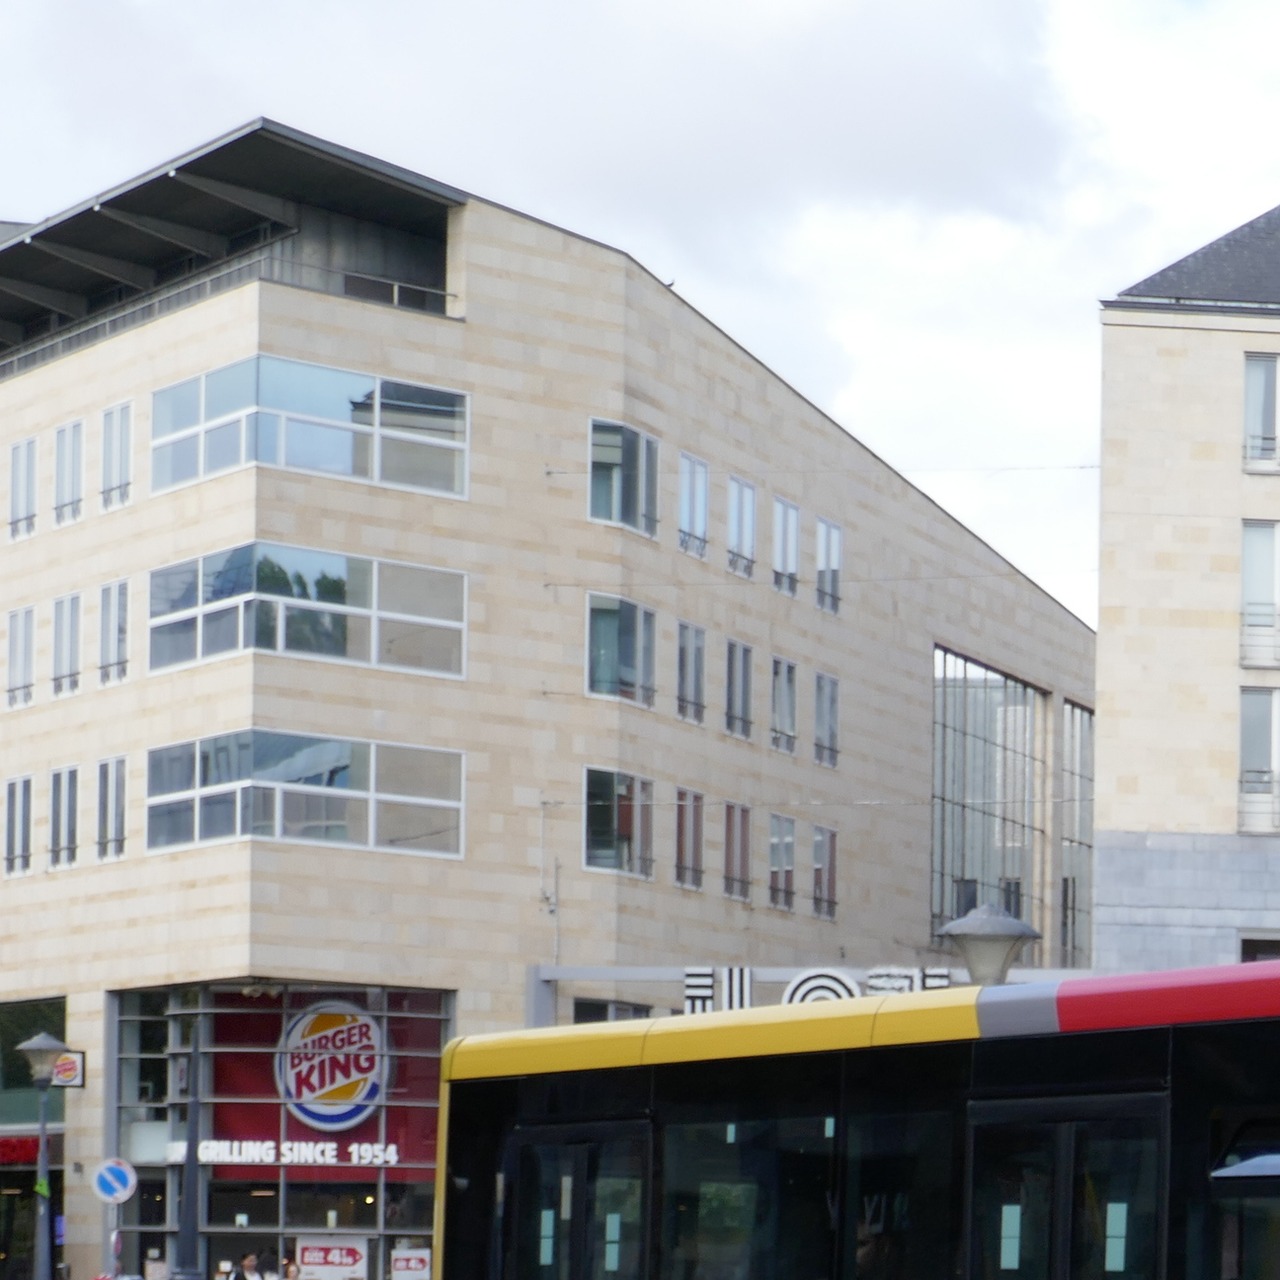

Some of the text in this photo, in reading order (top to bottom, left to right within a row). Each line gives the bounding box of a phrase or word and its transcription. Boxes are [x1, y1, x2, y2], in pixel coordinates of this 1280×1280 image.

[290, 1022, 372, 1070] BURGER
[292, 1044, 376, 1099] KING
[198, 1140, 276, 1163] GRILLING
[281, 1141, 338, 1163] SINCE
[348, 1142, 399, 1166] 1954
